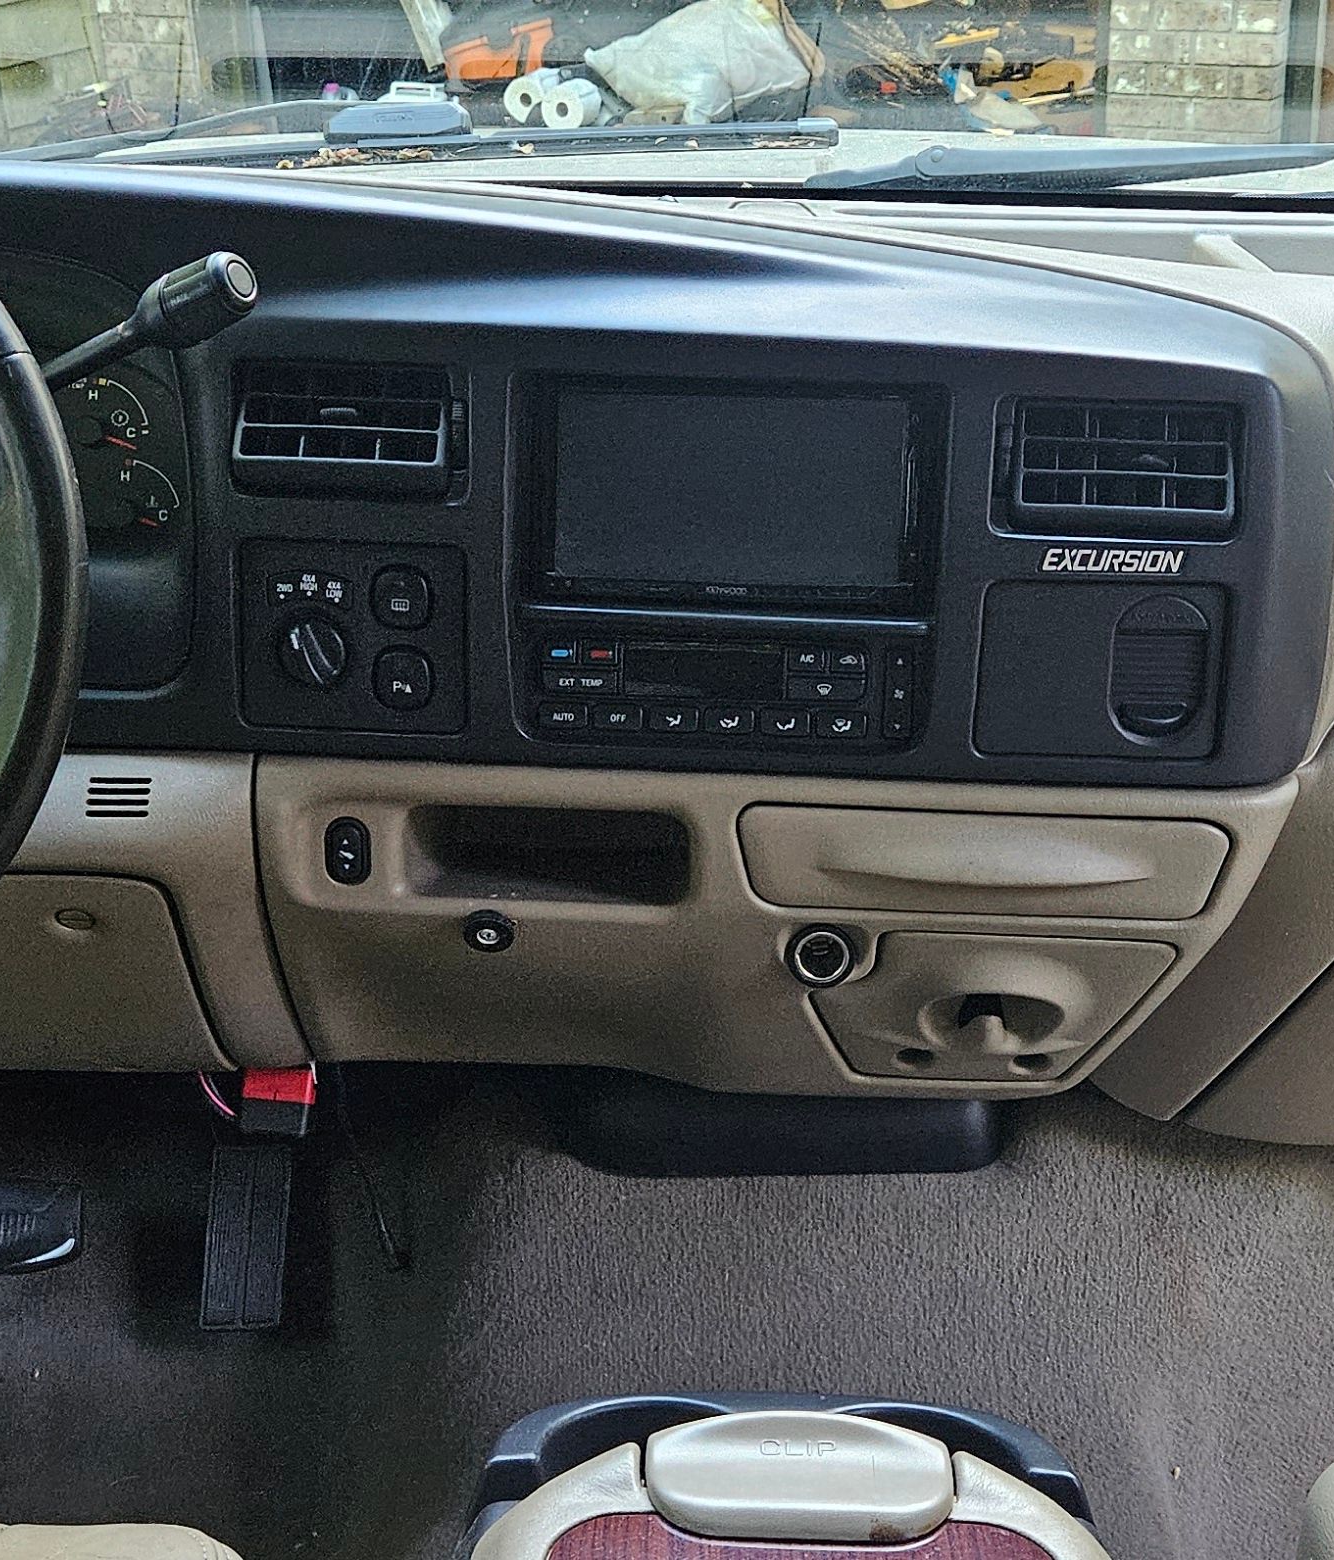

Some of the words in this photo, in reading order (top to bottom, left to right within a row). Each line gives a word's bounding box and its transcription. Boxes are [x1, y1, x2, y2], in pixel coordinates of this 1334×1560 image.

[88, 390, 98, 400] H
[126, 428, 137, 438] C
[120, 472, 131, 481] H
[158, 511, 168, 521] C
[1042, 549, 1184, 572] EXCURSION
[301, 574, 316, 582] 4X4
[276, 583, 293, 592] 2WD
[299, 582, 318, 591] HIGH
[327, 581, 341, 589] 4X4
[325, 589, 343, 598] LOW
[799, 654, 815, 663] A/C
[558, 678, 575, 686] EXT
[580, 678, 603, 687] TEMP
[552, 712, 575, 721] AUTO
[610, 713, 627, 722] OFF
[760, 1440, 837, 1457] CLIP
